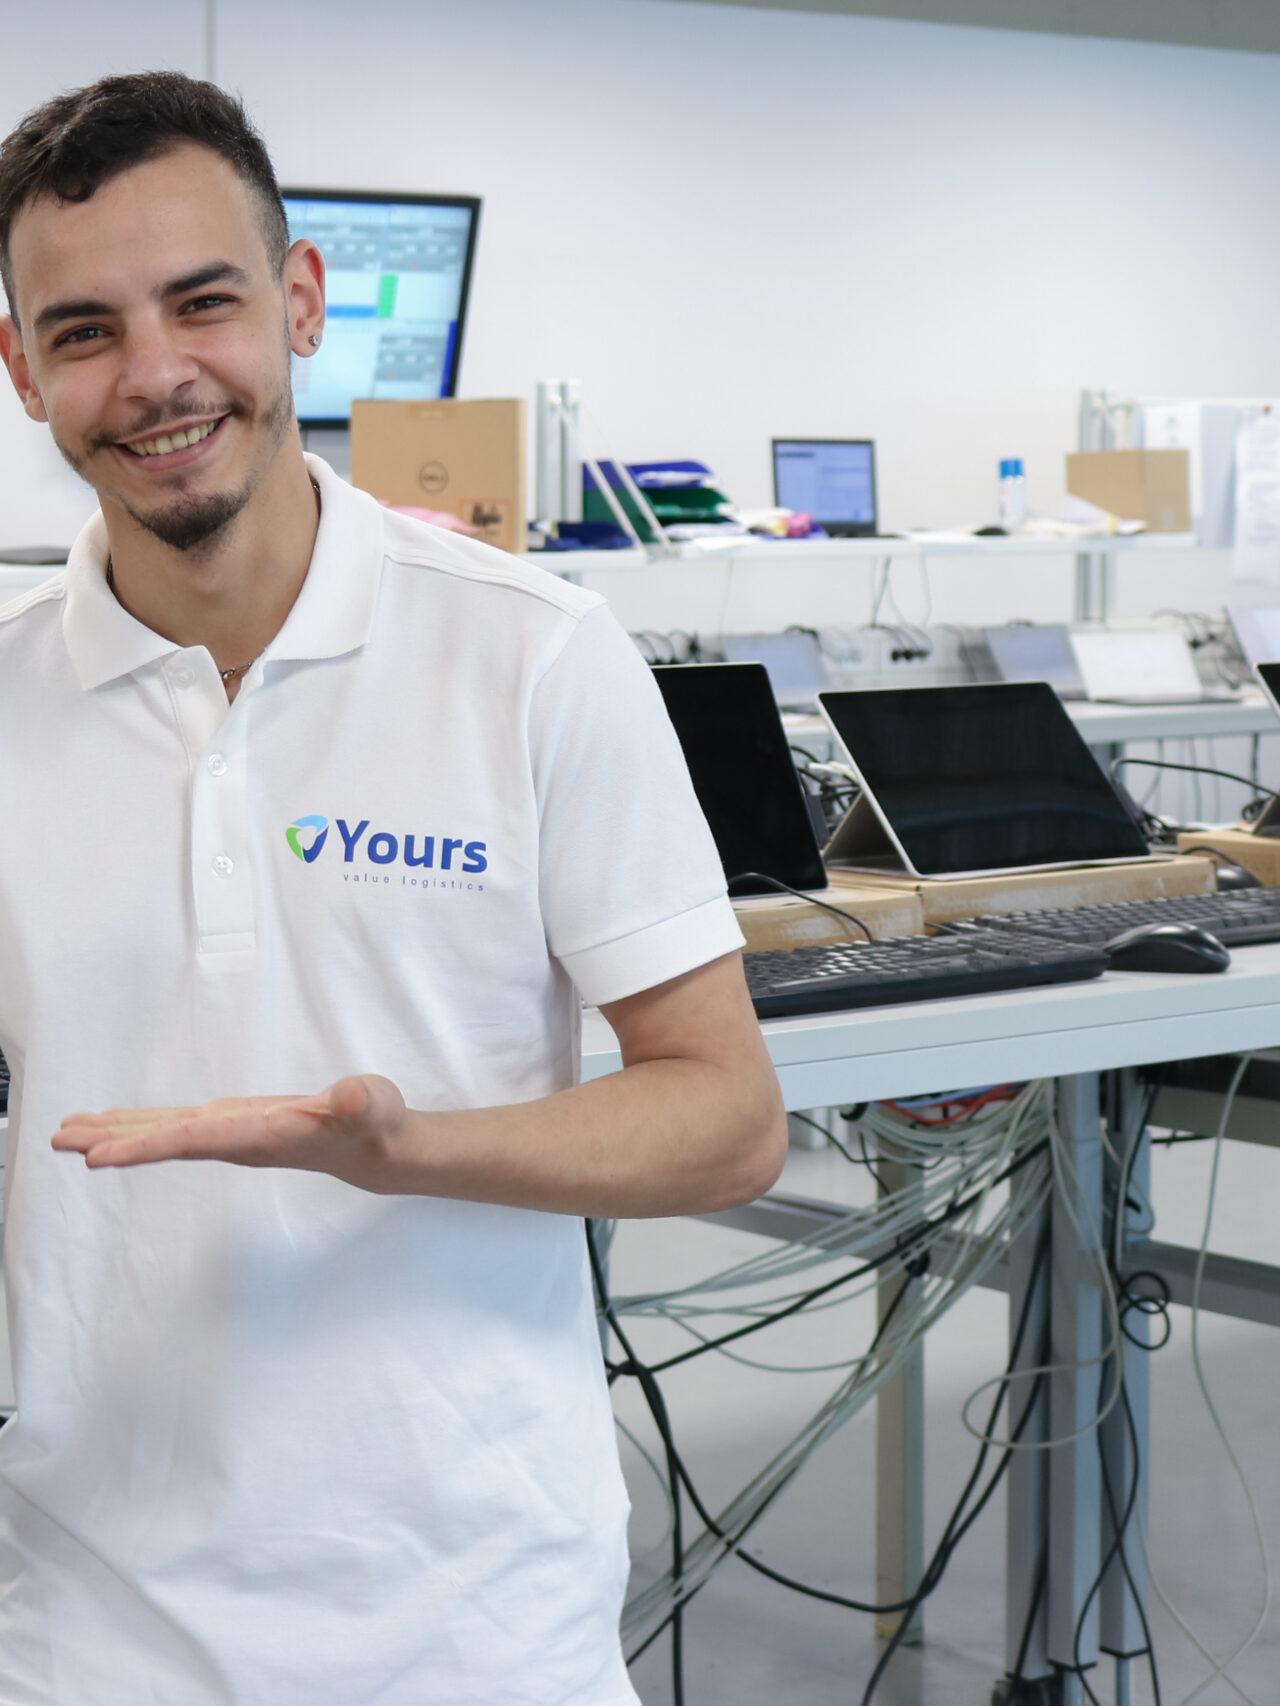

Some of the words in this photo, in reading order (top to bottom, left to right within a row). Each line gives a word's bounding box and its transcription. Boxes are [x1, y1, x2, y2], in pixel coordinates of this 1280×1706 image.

[335, 819, 488, 874] Yours
[343, 873, 390, 884] value
[402, 875, 484, 892] logistics
